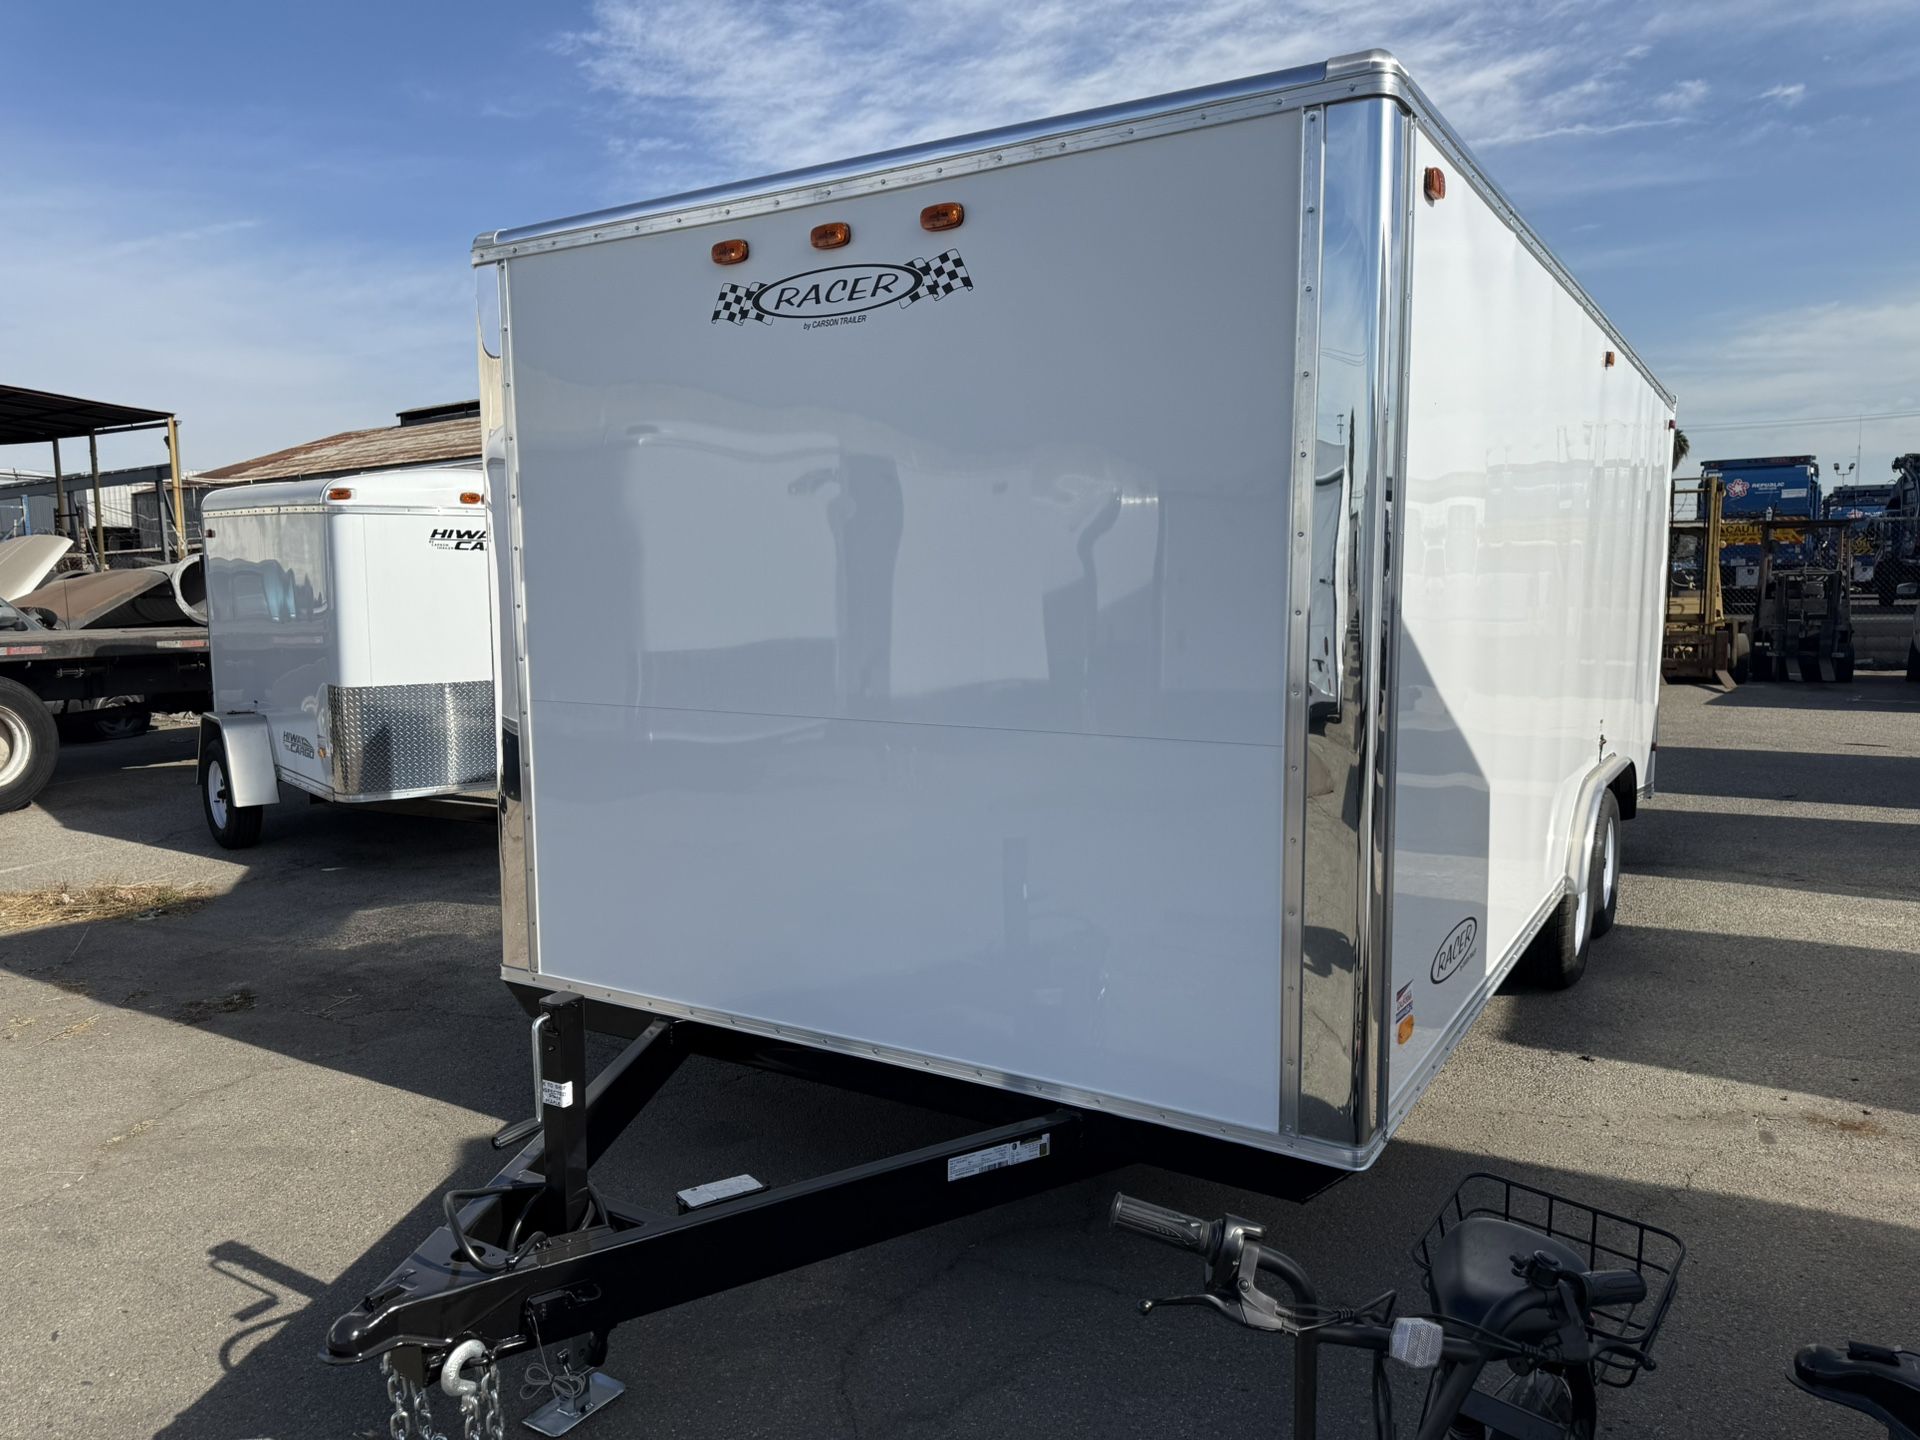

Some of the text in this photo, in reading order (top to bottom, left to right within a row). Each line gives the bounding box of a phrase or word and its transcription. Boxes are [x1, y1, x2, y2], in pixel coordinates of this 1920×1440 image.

[774, 273, 899, 310] RACER
[803, 315, 867, 331] by CARSON TRAILER
[455, 541, 487, 551] CA
[291, 743, 314, 760] CARGO
[1437, 924, 1473, 977] RACER
